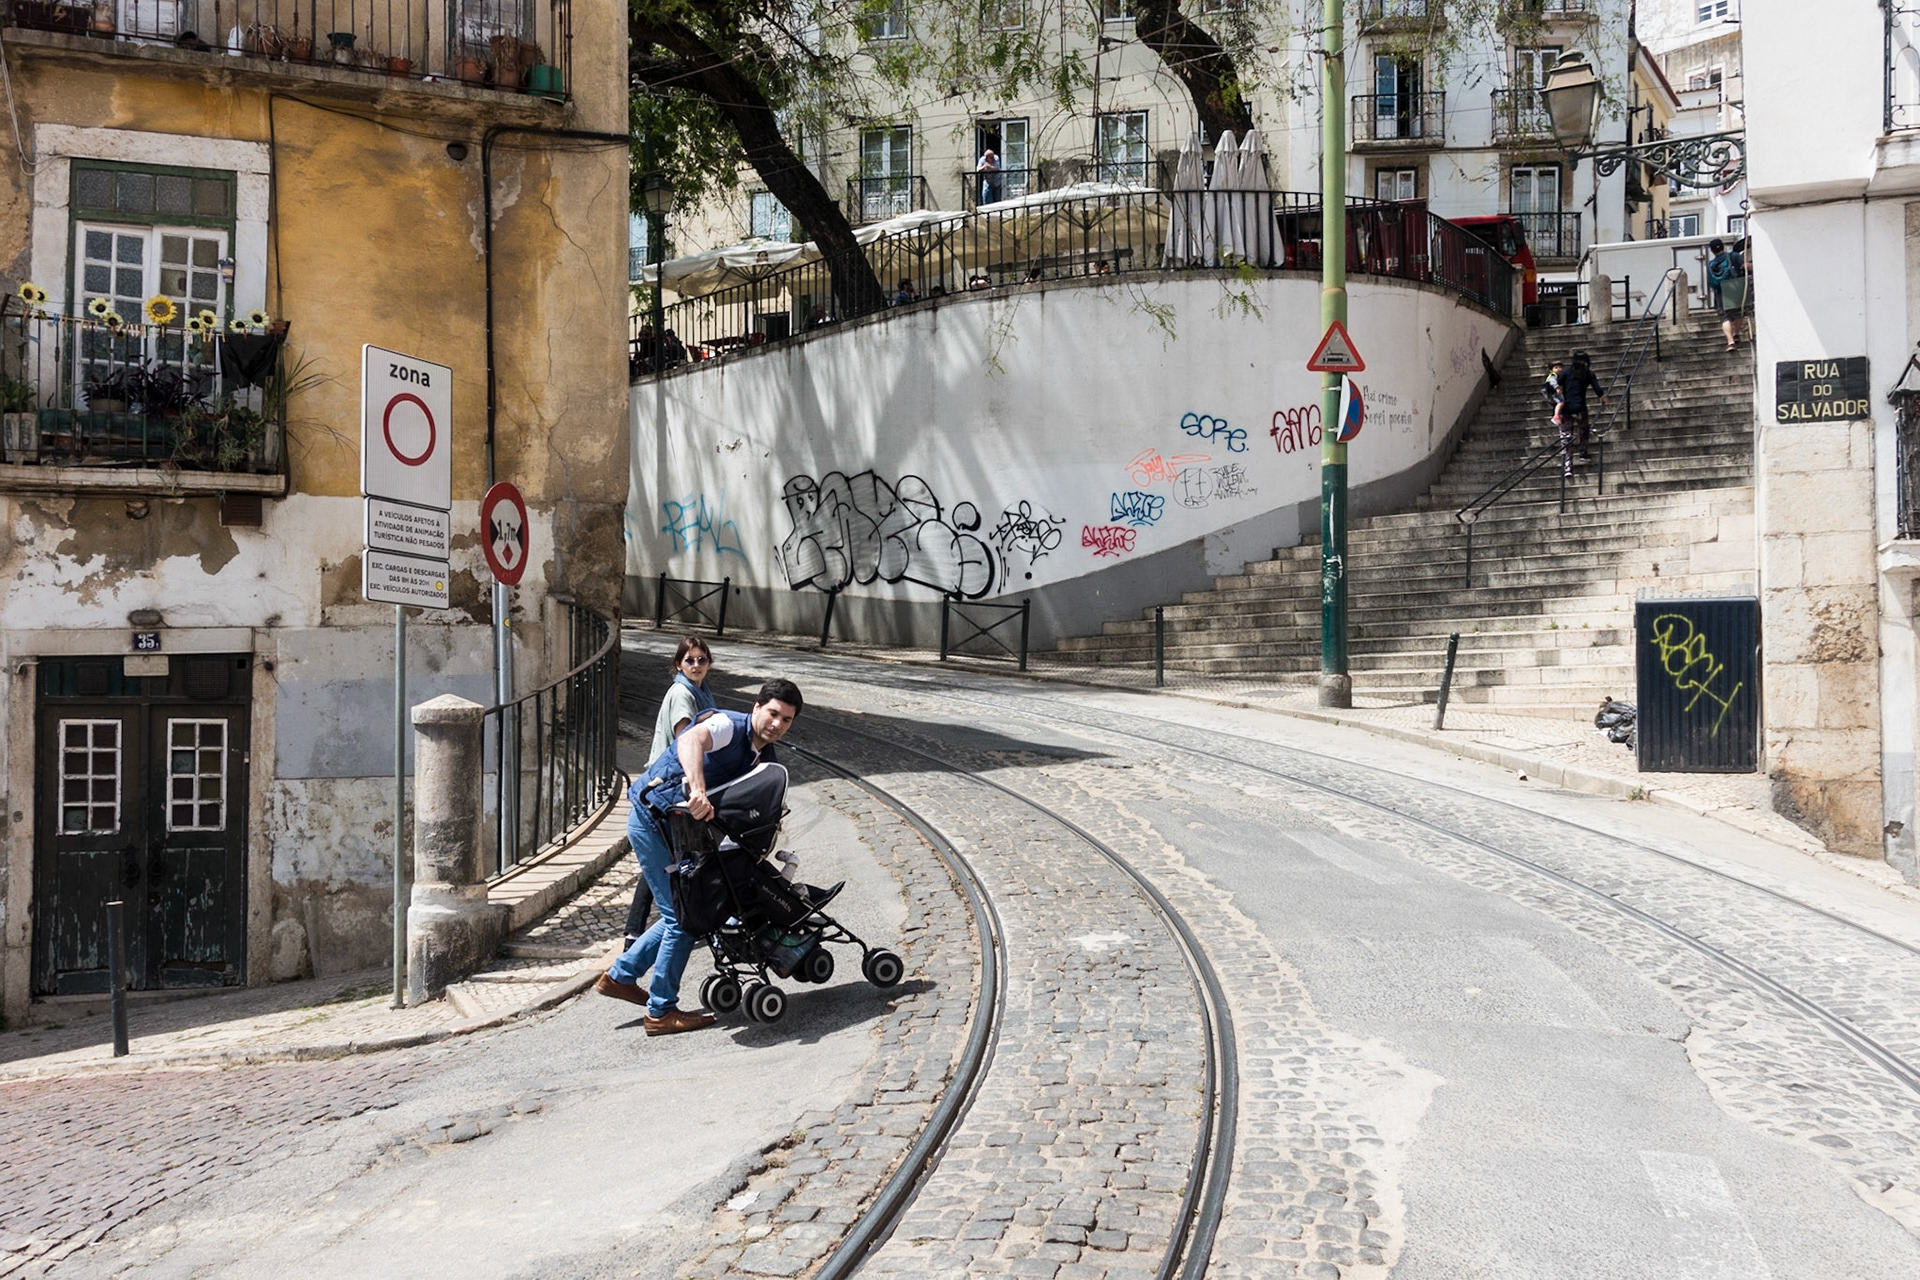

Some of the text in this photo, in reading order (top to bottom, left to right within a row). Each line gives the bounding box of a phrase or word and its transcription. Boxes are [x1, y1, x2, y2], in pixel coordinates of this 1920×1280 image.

[390, 363, 430, 387] zona
[1804, 363, 1840, 379] RUA
[1812, 384, 1832, 396] DO
[1777, 399, 1869, 419] SALVADOR
[384, 511, 412, 522] VEÍCULOS
[414, 516, 434, 525] AFETOS
[374, 521, 404, 532] ATIVIDADE
[414, 528, 444, 539] ANIMAÇÃO
[374, 531, 445, 549] TURÍSTICA NÃO PESADOS
[372, 562, 384, 570] EXC.
[385, 564, 408, 573] CARGAS
[413, 568, 446, 578] DESCARGAS
[383, 584, 410, 594] VEÍCULOS
[411, 588, 447, 599] AUTORIZADOS
